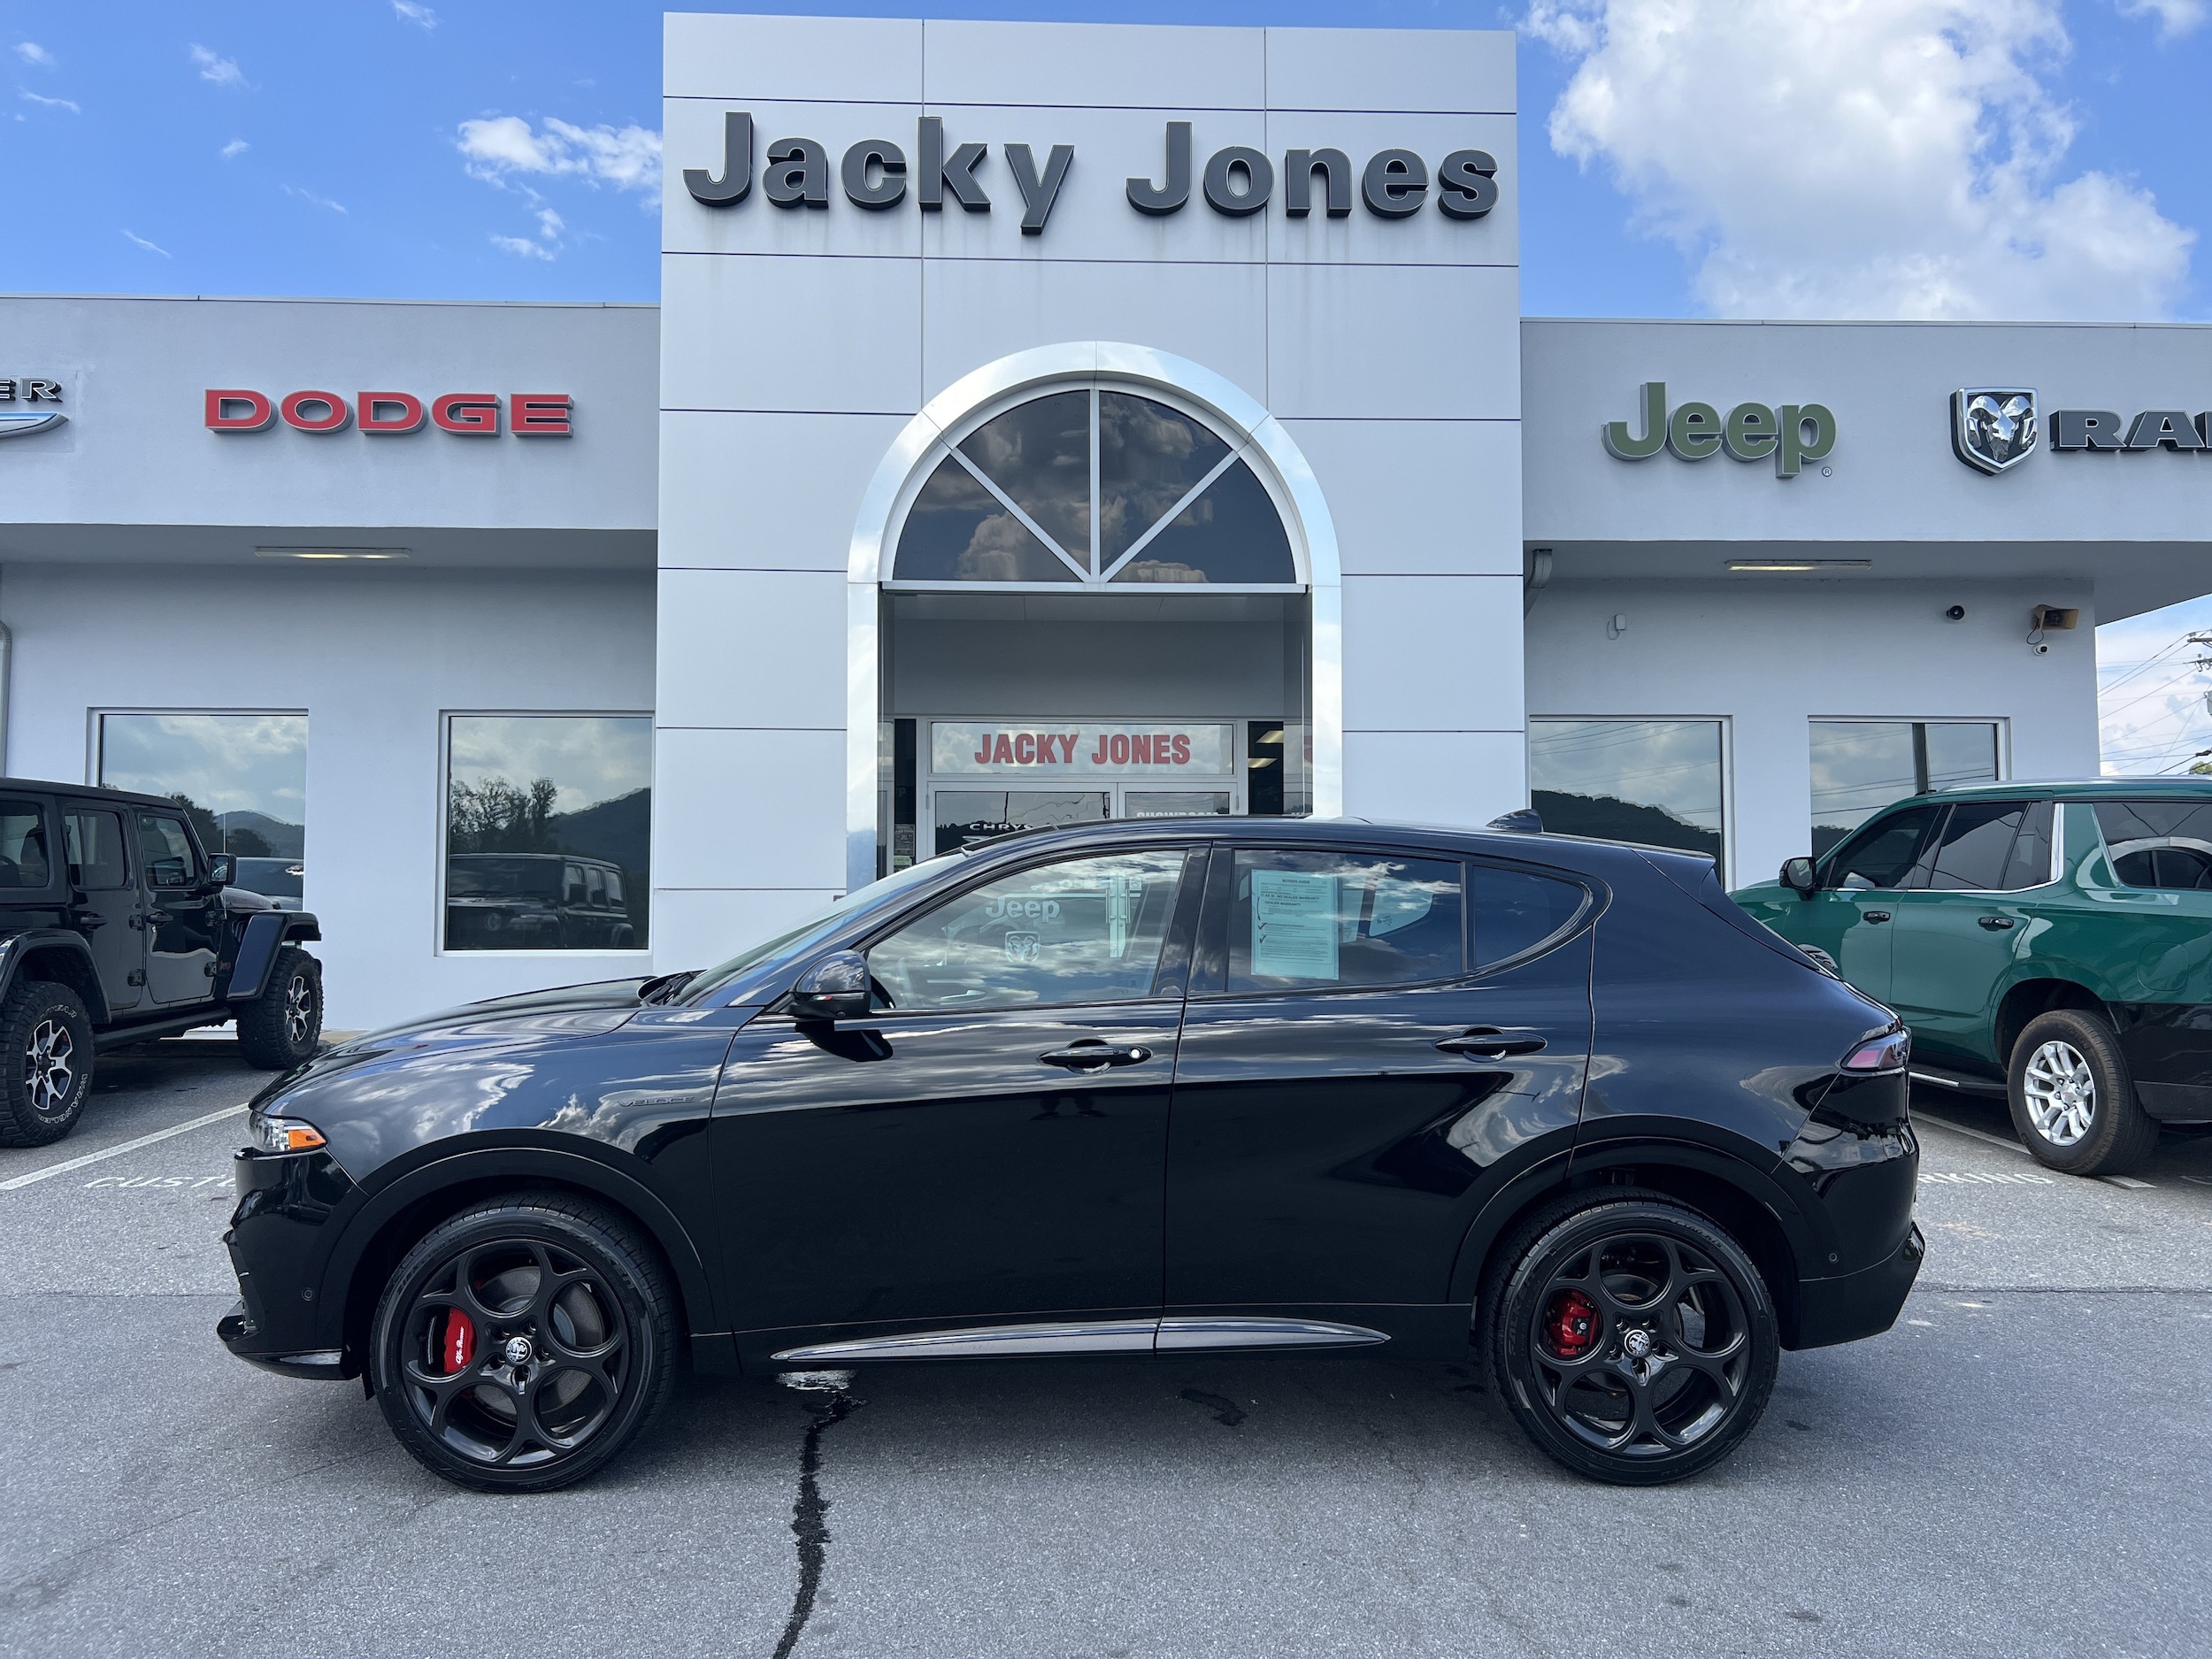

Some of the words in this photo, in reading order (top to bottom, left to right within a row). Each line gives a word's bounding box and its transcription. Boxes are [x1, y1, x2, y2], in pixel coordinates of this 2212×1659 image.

[682, 111, 1074, 235] Jacky
[1125, 121, 1500, 220] Jones
[204, 388, 574, 437] DODGE
[1601, 381, 1837, 479] Jeep
[2049, 409, 2212, 452] RA
[974, 733, 1079, 764] JACKY
[1091, 733, 1191, 764] JONES
[969, 823, 1034, 832] CHRYS
[986, 895, 1060, 923] Jeep
[84, 1176, 236, 1188] CUST
[1917, 1173, 2054, 1184] RKING
